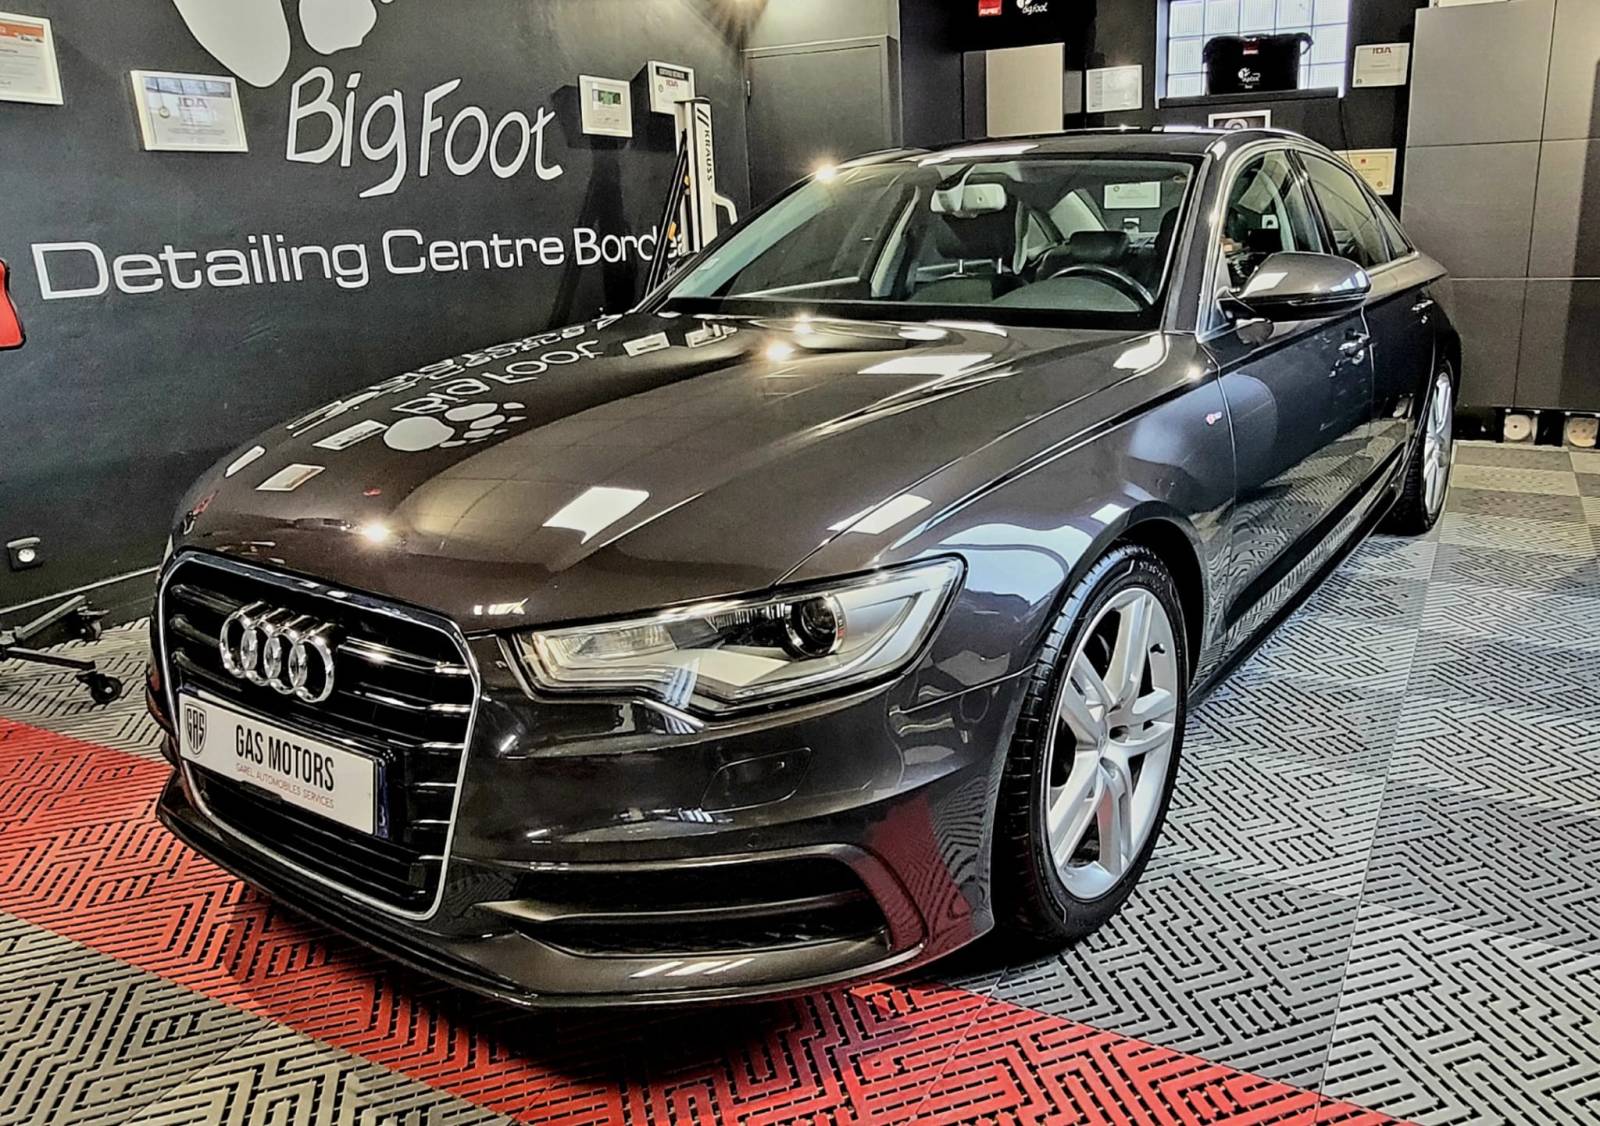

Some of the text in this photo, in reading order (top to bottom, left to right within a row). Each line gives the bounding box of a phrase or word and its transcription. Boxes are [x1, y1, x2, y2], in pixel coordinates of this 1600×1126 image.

[178, 96, 208, 109] IDA
[704, 130, 713, 181] KRAUSS
[31, 234, 369, 300] Detailing
[383, 229, 565, 273] Centre
[236, 724, 334, 791] GAS MOTORS
[256, 770, 302, 796] AUTOMOBILES
[303, 788, 335, 808] SERVICES
